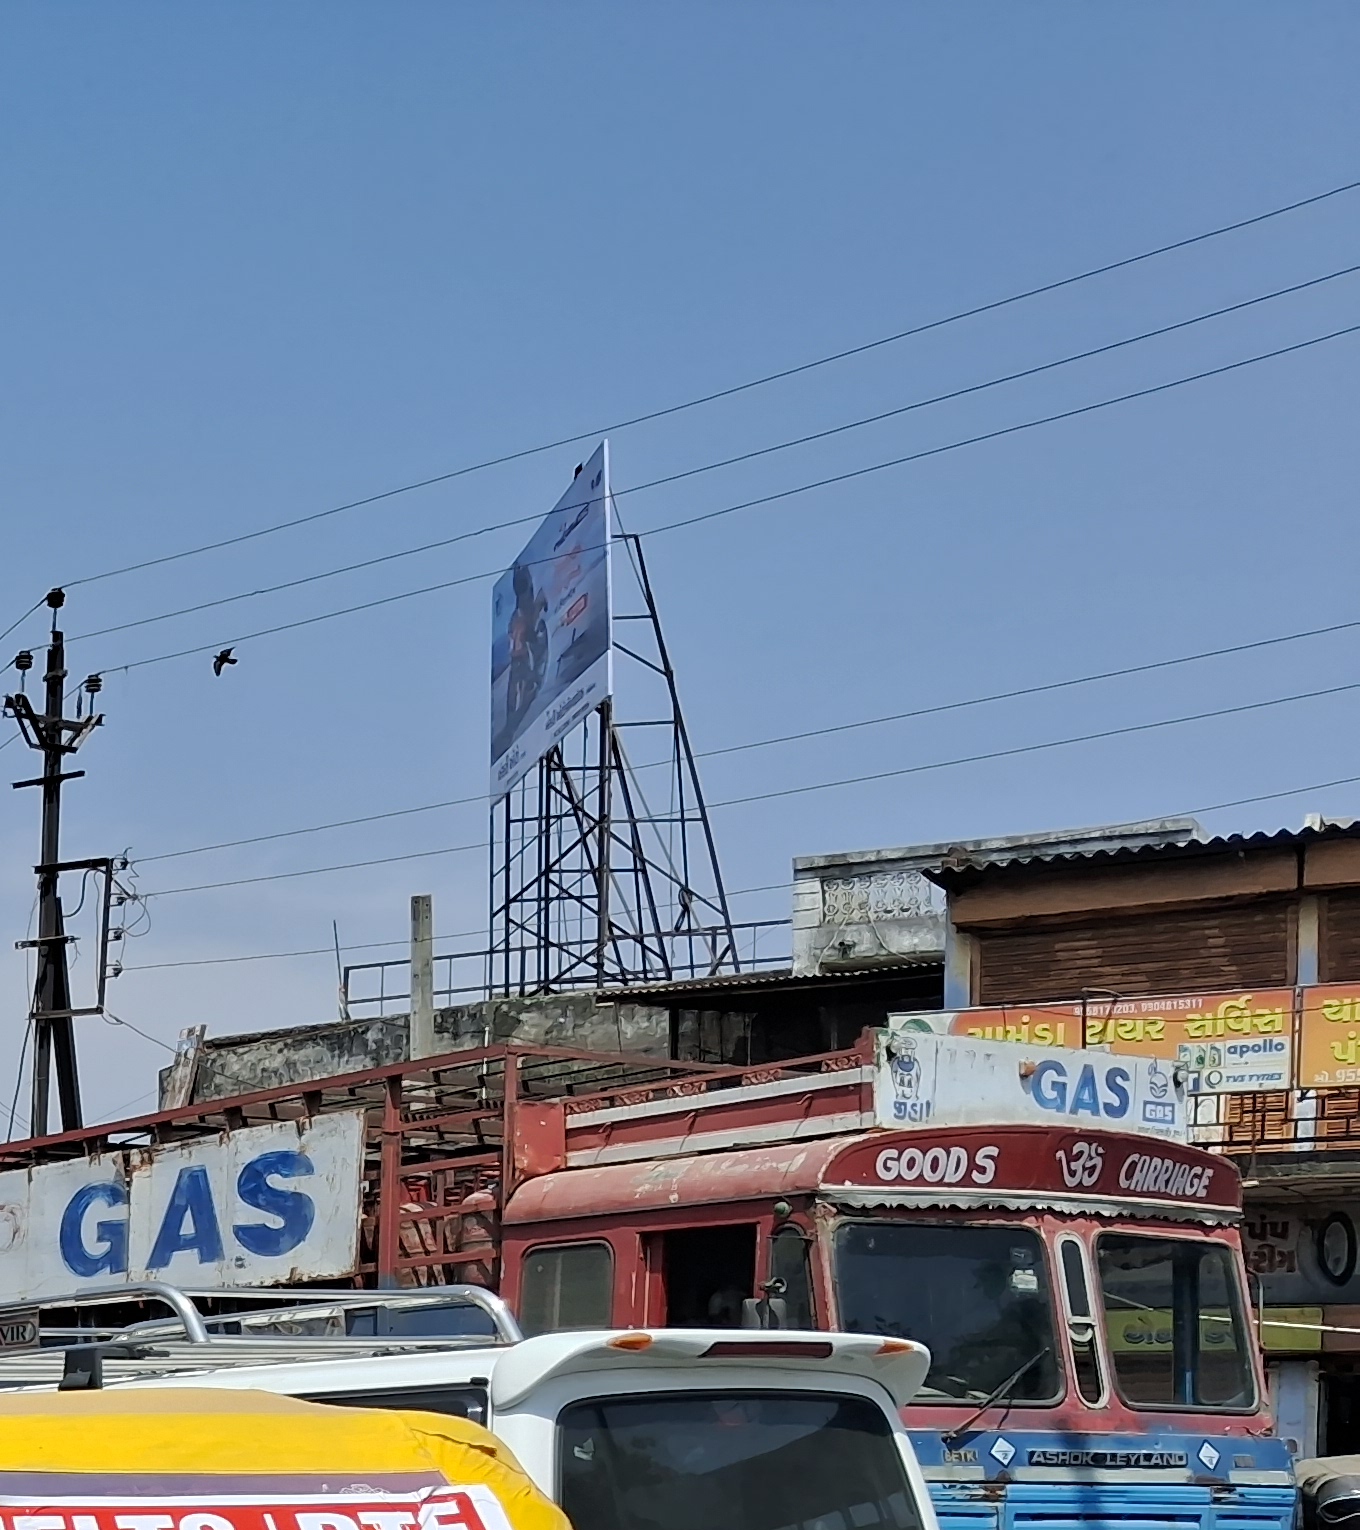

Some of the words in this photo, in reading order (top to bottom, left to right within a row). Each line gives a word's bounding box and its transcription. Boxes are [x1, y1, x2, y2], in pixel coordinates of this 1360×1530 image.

[1226, 1039, 1285, 1059] apollo
[1031, 1060, 1131, 1119] GAS
[875, 1146, 1000, 1185] GOODS
[1118, 1152, 1214, 1198] CARRIAGE
[59, 1150, 316, 1278] GAS
[1031, 1450, 1094, 1466] ASHOK
[1105, 1451, 1187, 1467] LEYLAND
